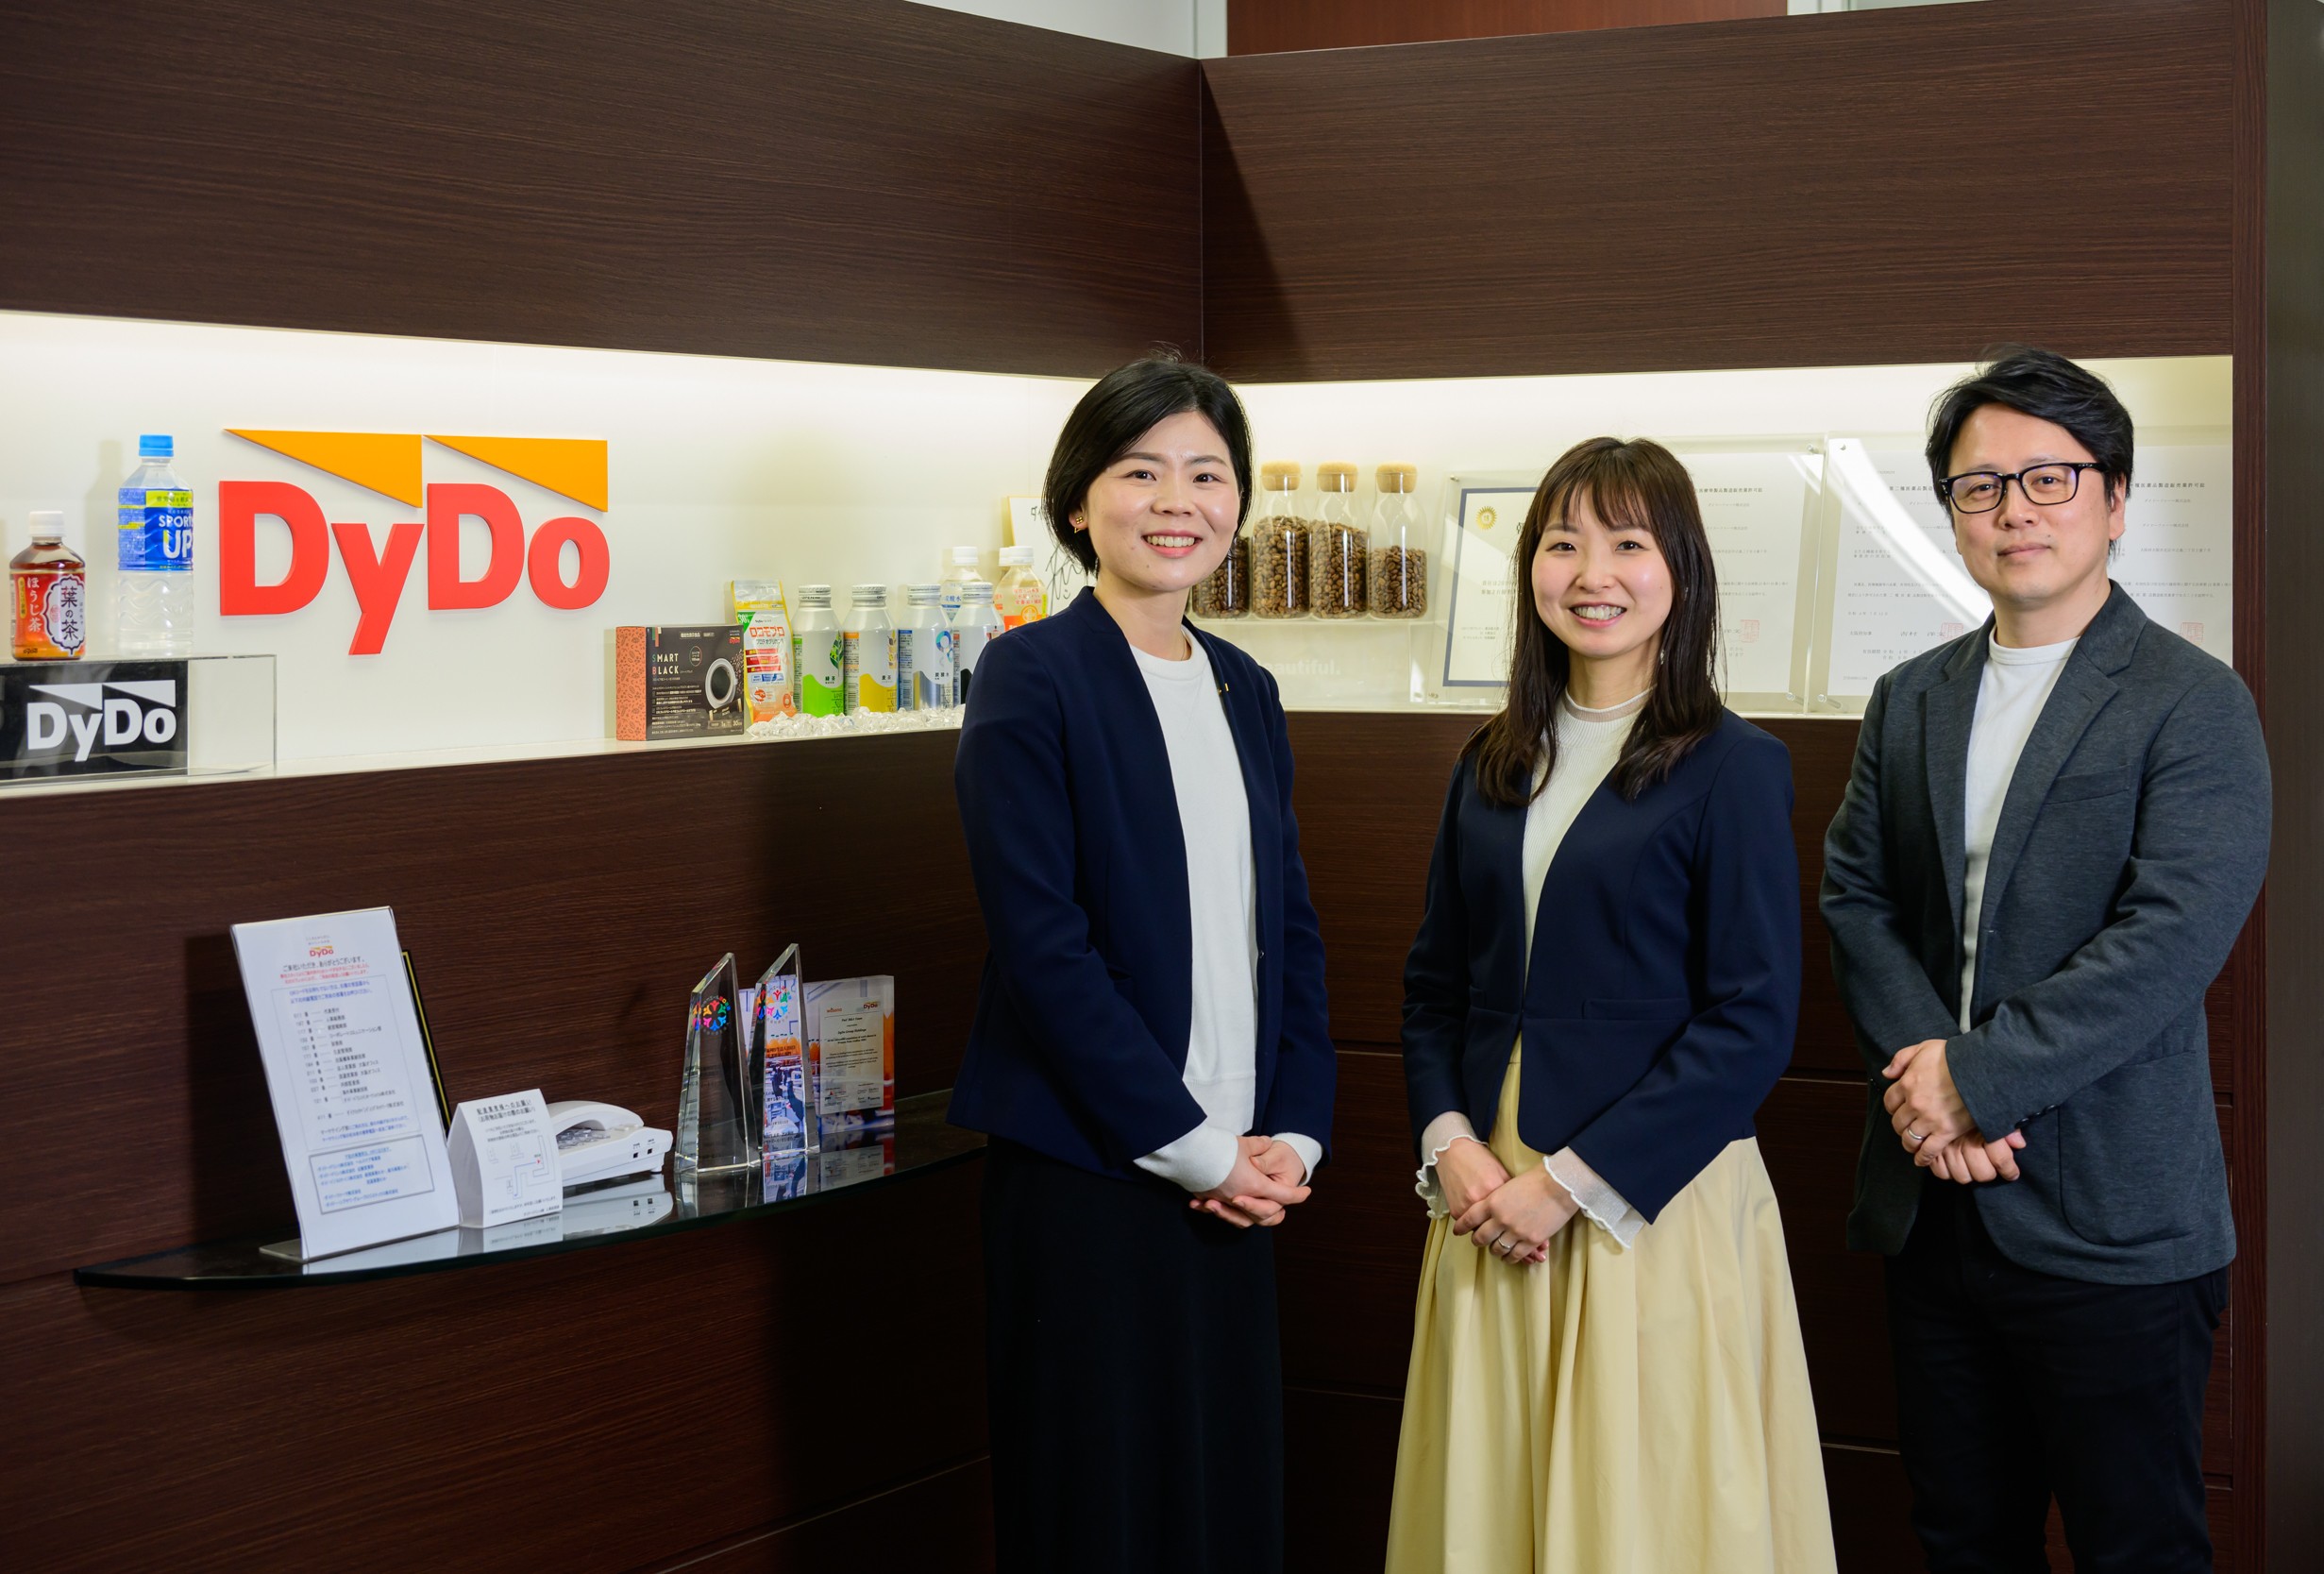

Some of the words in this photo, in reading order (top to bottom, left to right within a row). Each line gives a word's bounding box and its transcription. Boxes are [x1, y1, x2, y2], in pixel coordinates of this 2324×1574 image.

[163, 530, 192, 559] UP
[220, 481, 610, 655] DyDo
[27, 577, 42, 633] ほうじ茶
[61, 586, 79, 640] 葉の茶
[652, 653, 679, 663] SMART
[652, 666, 679, 675] BLACK
[26, 699, 177, 762] DyDo
[310, 948, 334, 957] DyDo
